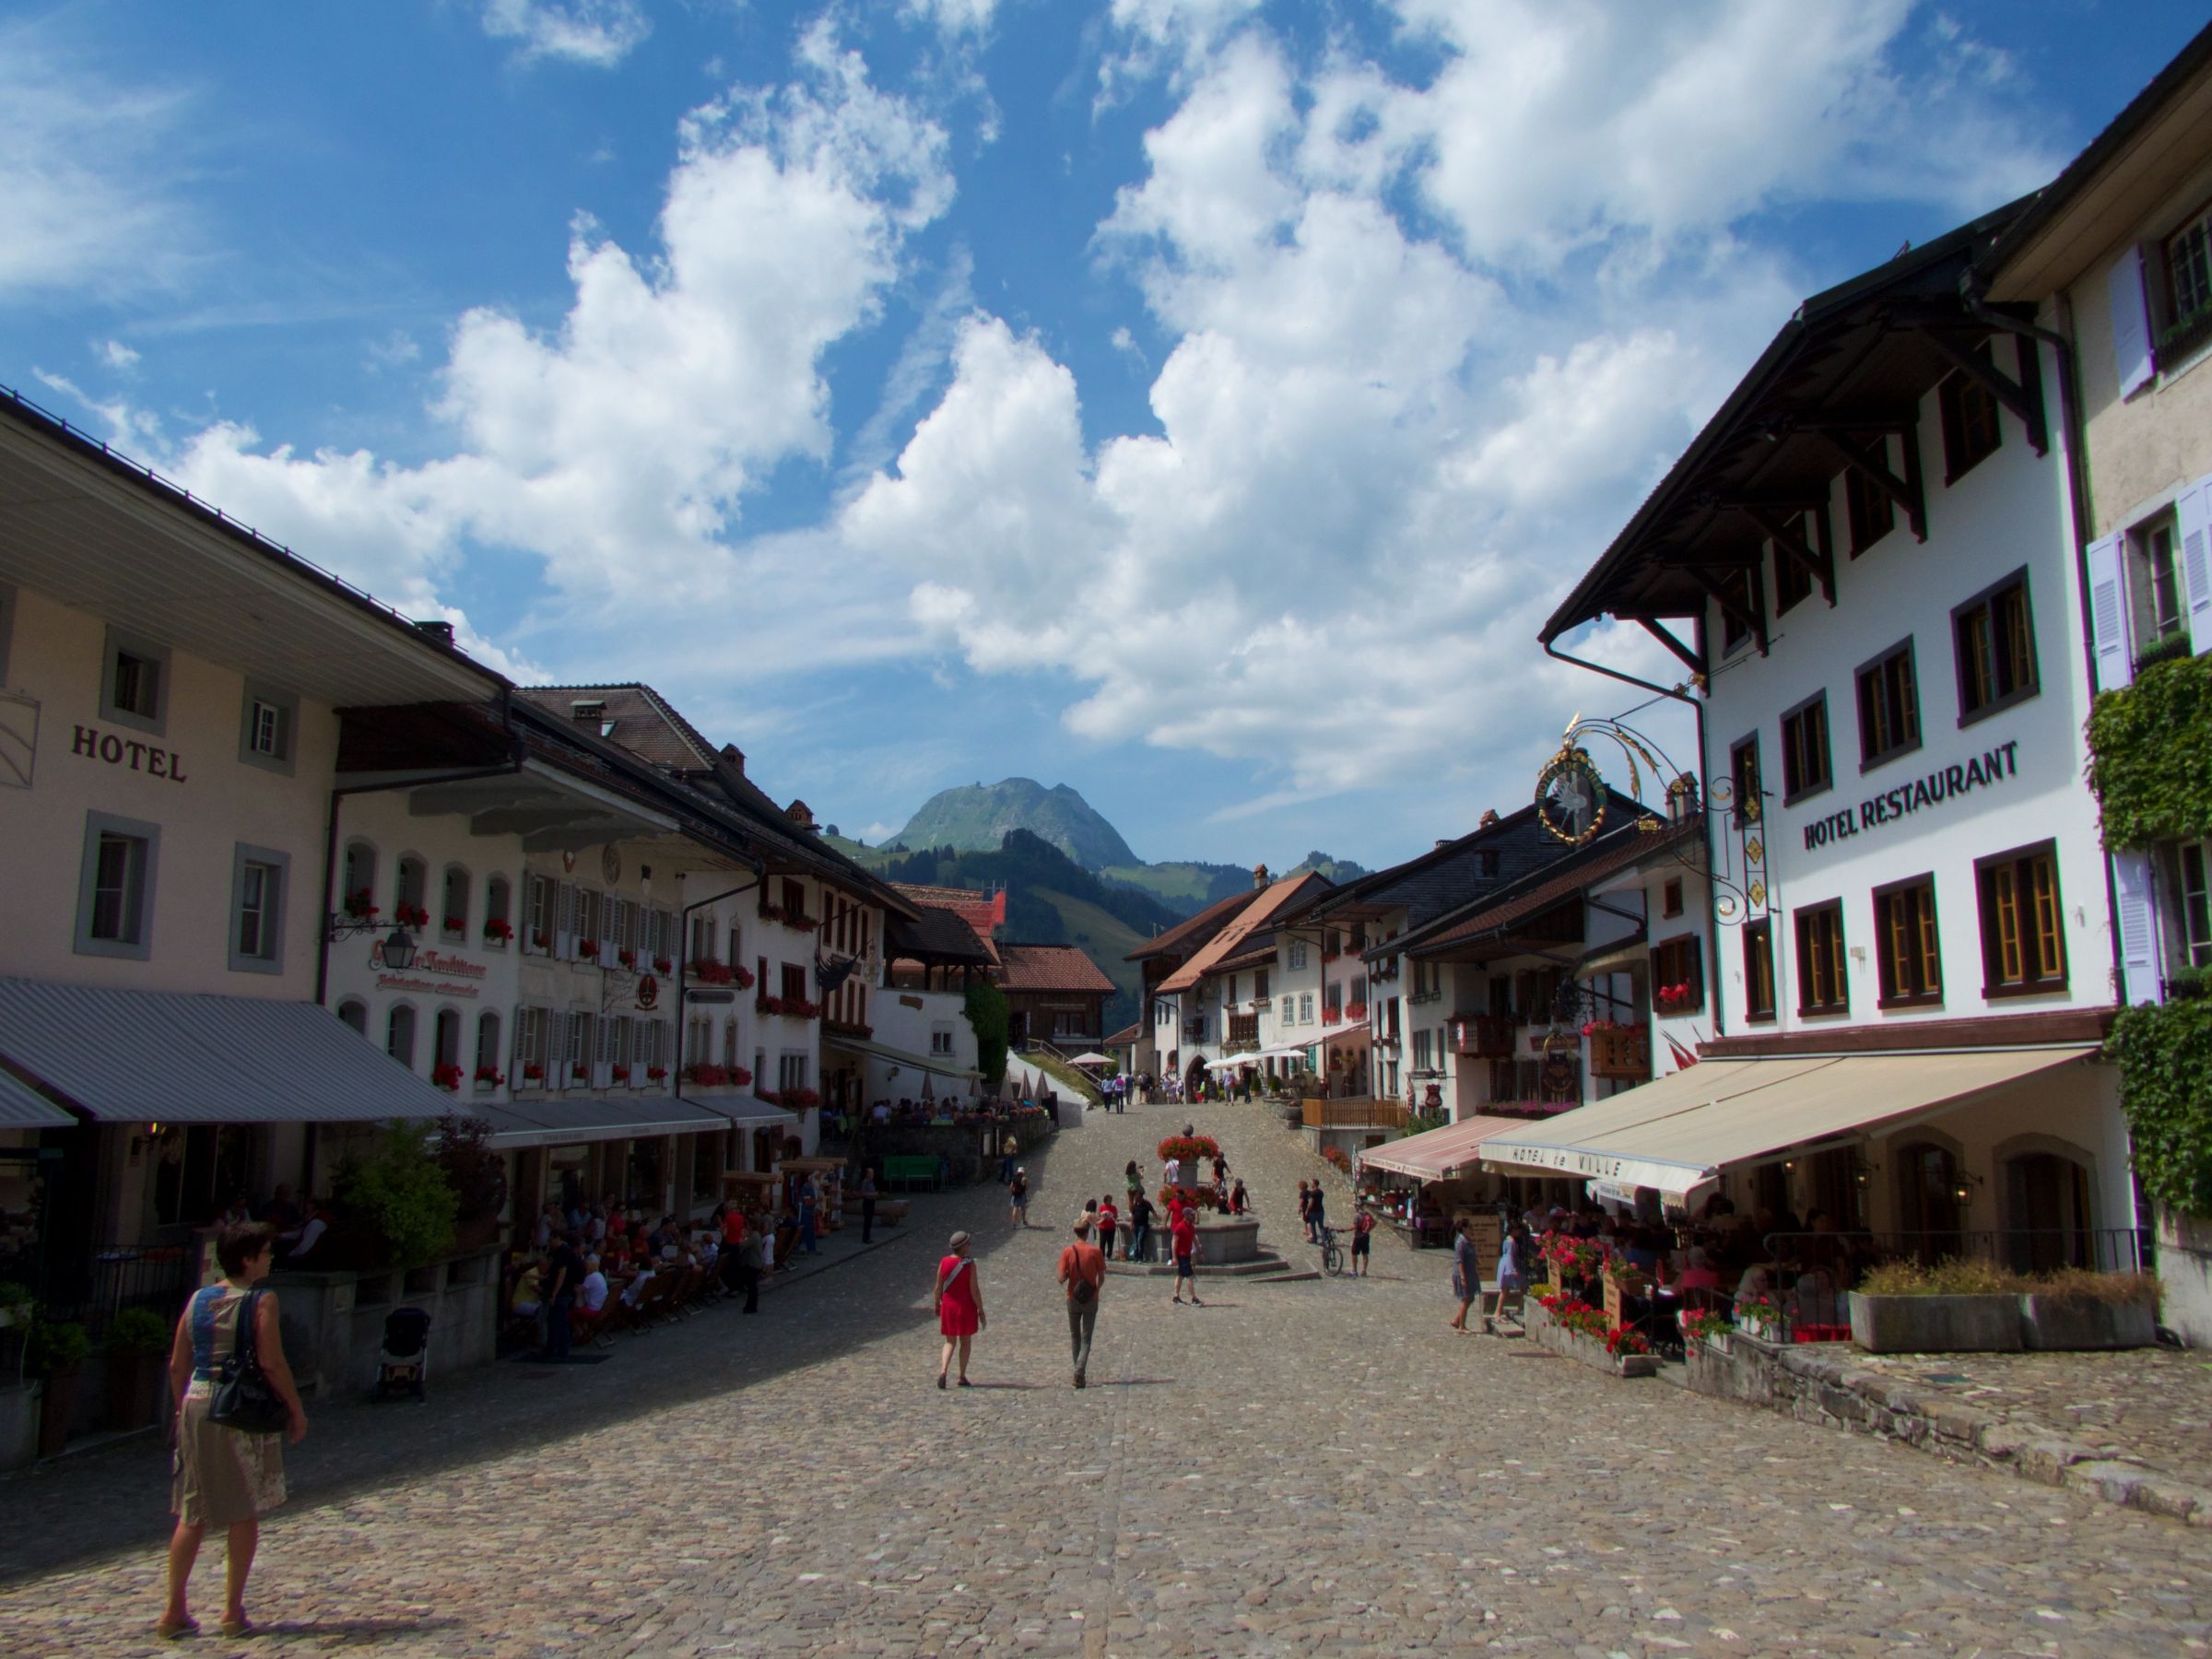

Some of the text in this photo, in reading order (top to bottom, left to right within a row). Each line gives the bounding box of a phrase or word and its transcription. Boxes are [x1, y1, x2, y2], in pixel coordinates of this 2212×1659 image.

[71, 724, 187, 783] HOTEL
[1563, 761, 1579, 771] DE
[1804, 740, 2018, 851] HOTEL RESTAURANT
[1512, 1148, 1544, 1163] HOTEL
[1578, 1154, 1621, 1177] VILLE
